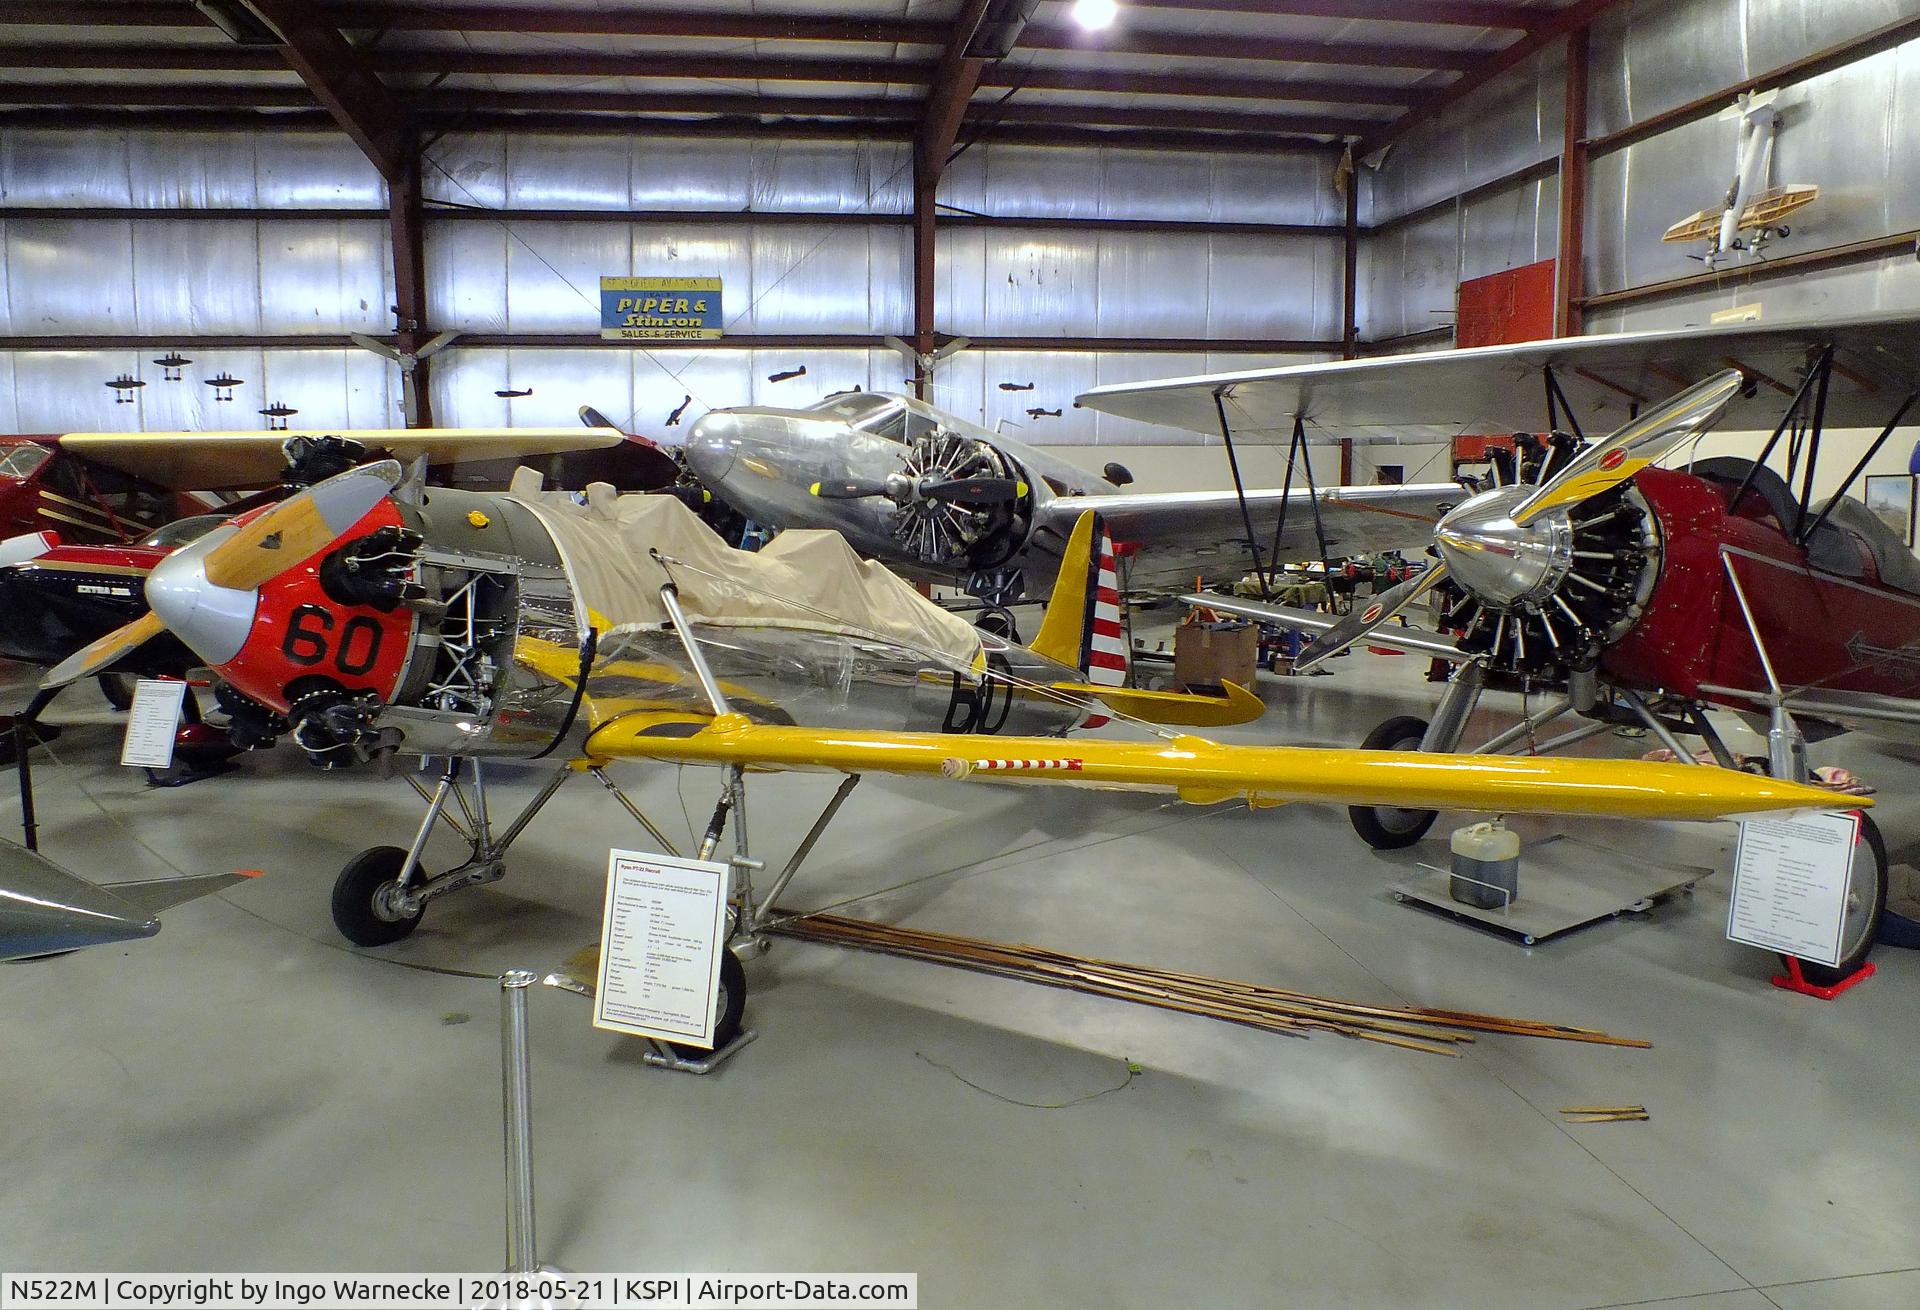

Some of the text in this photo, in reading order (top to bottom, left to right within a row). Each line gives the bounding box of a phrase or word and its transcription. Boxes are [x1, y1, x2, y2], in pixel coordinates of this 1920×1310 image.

[616, 298, 708, 313] PIPER &
[622, 314, 703, 328] Stinson
[622, 330, 649, 339] SALES
[664, 330, 702, 339] SERVICE
[282, 603, 384, 676] 60
